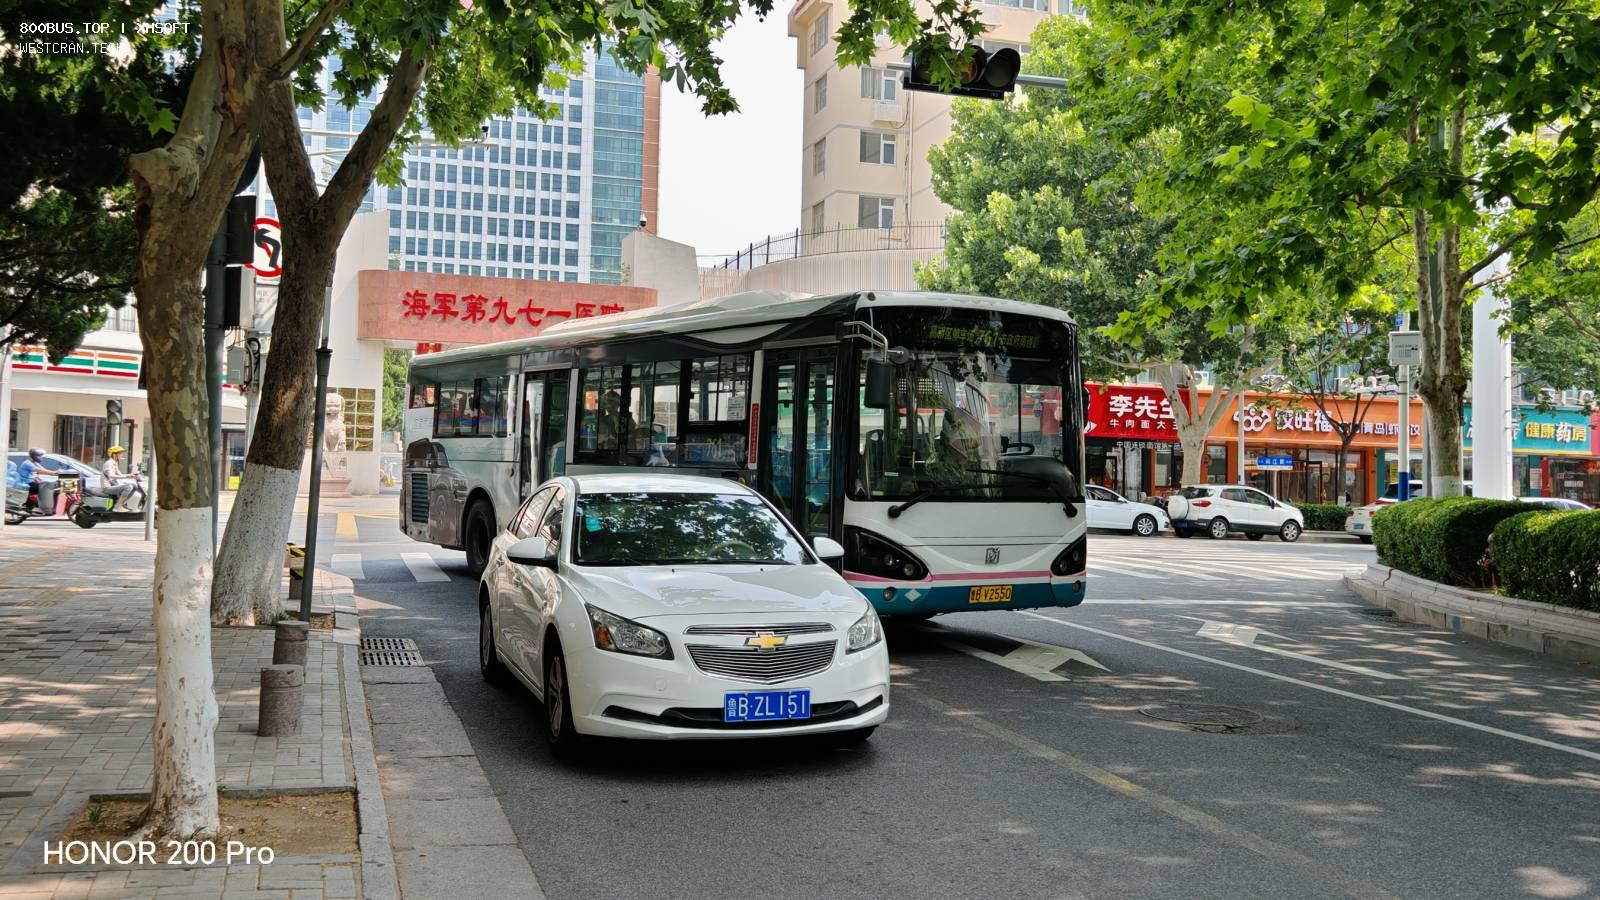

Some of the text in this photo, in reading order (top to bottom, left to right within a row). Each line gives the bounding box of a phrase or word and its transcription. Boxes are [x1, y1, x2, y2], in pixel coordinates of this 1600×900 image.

[1275, 408, 1333, 433] 饺旺福
[1525, 421, 1587, 443] 健康药房
